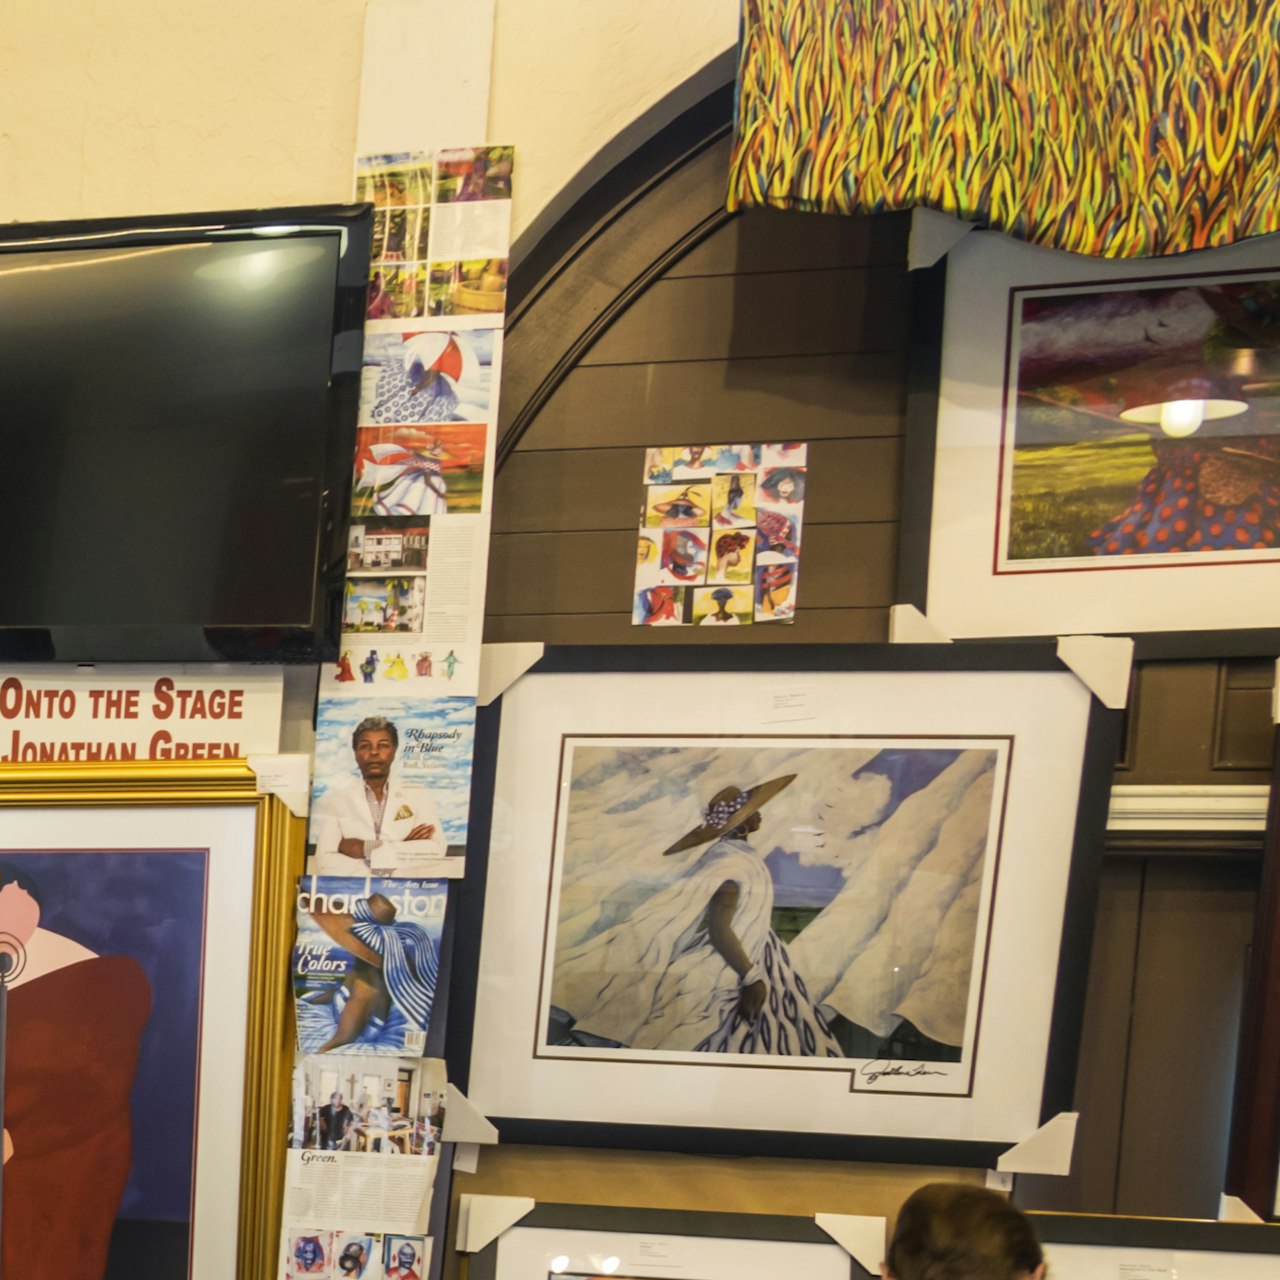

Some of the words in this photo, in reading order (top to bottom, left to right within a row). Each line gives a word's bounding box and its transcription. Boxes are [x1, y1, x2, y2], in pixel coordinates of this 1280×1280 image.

[88, 689, 139, 719] THE
[152, 677, 244, 720] STAGE
[405, 728, 462, 743] Rhapsody
[403, 742, 415, 752] in
[417, 742, 444, 752] Blue
[297, 876, 446, 915] charlston
[296, 942, 331, 955] True
[297, 954, 347, 974] Colors
[301, 1151, 337, 1165] Green.
